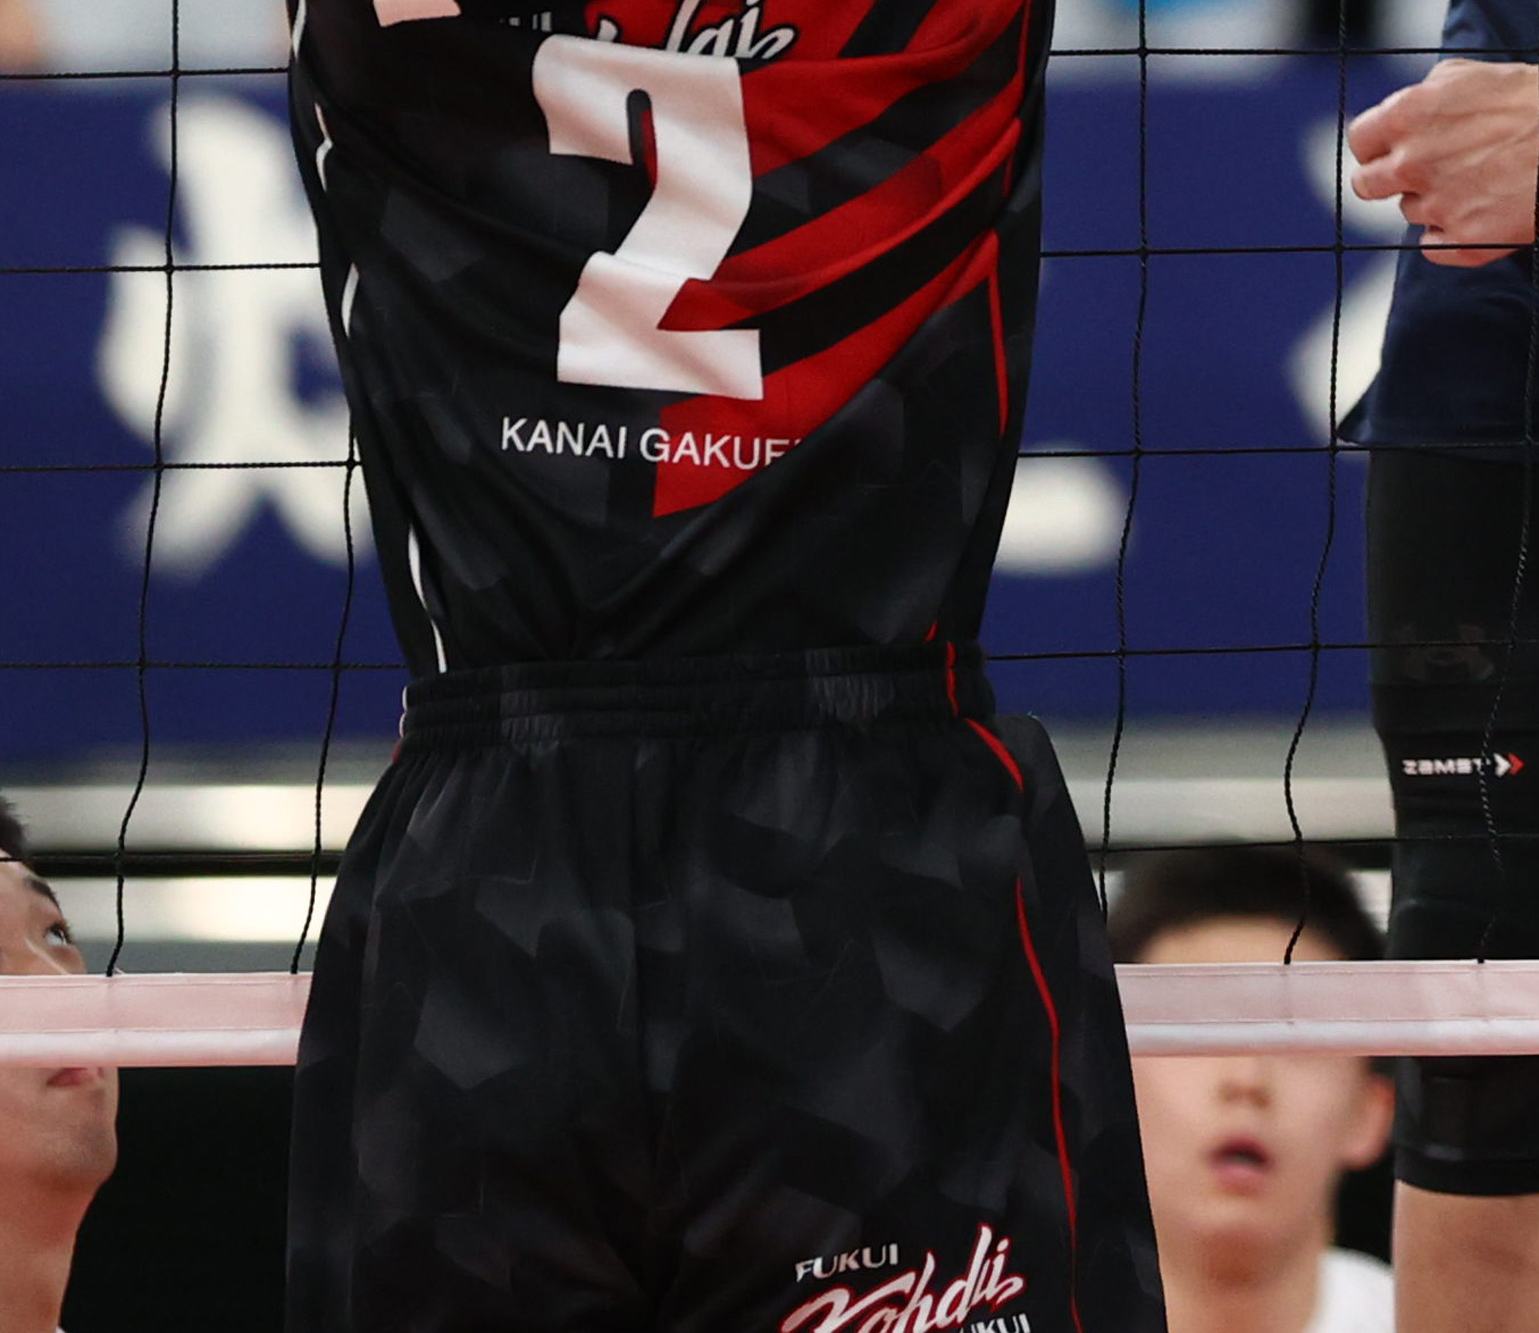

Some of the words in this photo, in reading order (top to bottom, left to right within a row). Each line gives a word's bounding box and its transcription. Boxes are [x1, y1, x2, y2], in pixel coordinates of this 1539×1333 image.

[532, 33, 764, 401] 2
[501, 416, 627, 460] KANAI
[639, 428, 802, 471] GAKUE
[795, 1243, 898, 1283] FUKUI
